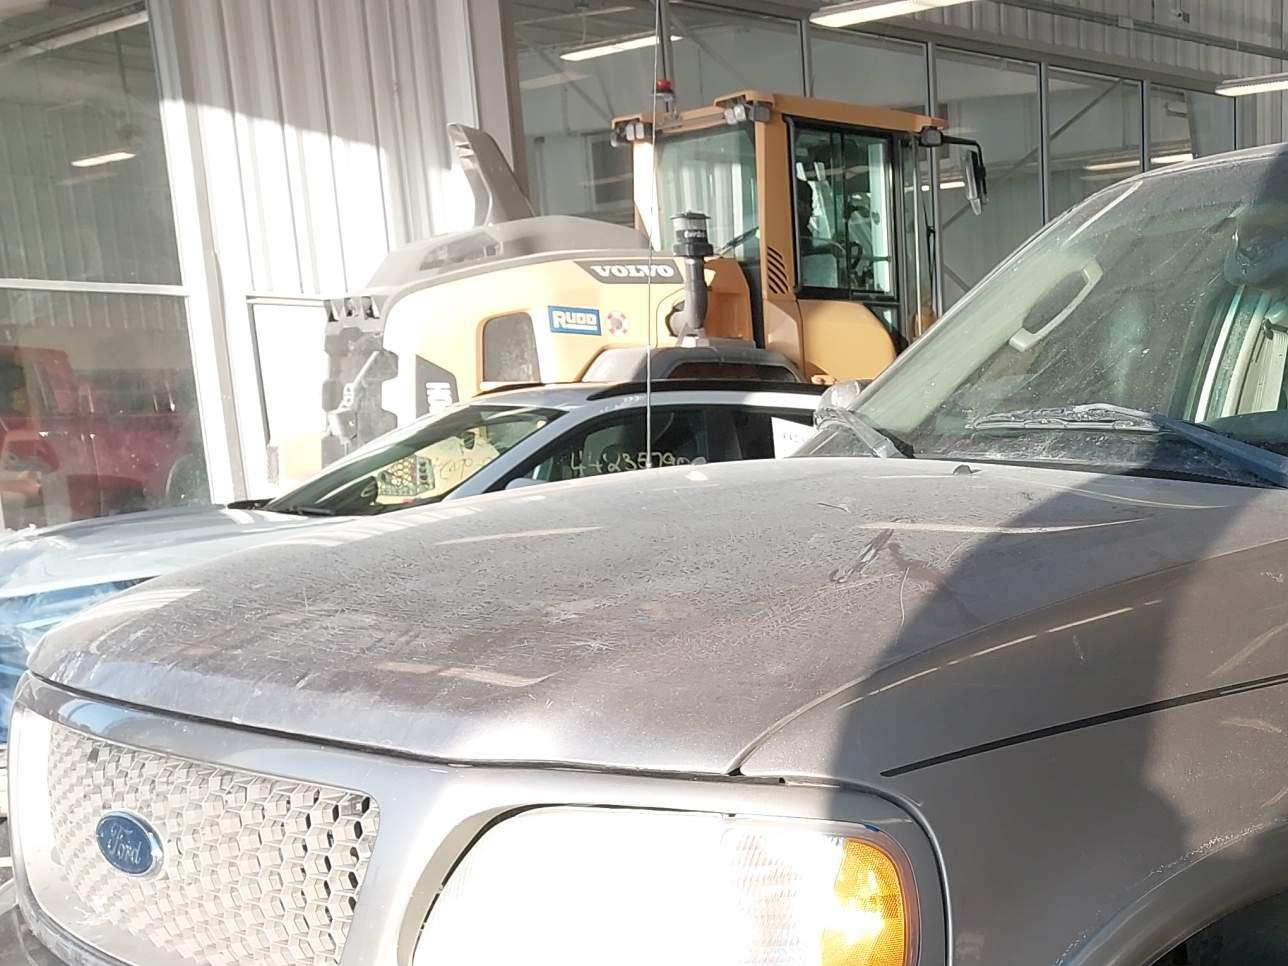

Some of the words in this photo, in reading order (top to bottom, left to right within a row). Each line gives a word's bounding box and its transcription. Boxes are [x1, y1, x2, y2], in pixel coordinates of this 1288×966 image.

[589, 264, 676, 278] VOLVO
[552, 310, 598, 329] RUDD
[106, 821, 143, 865] Ford
